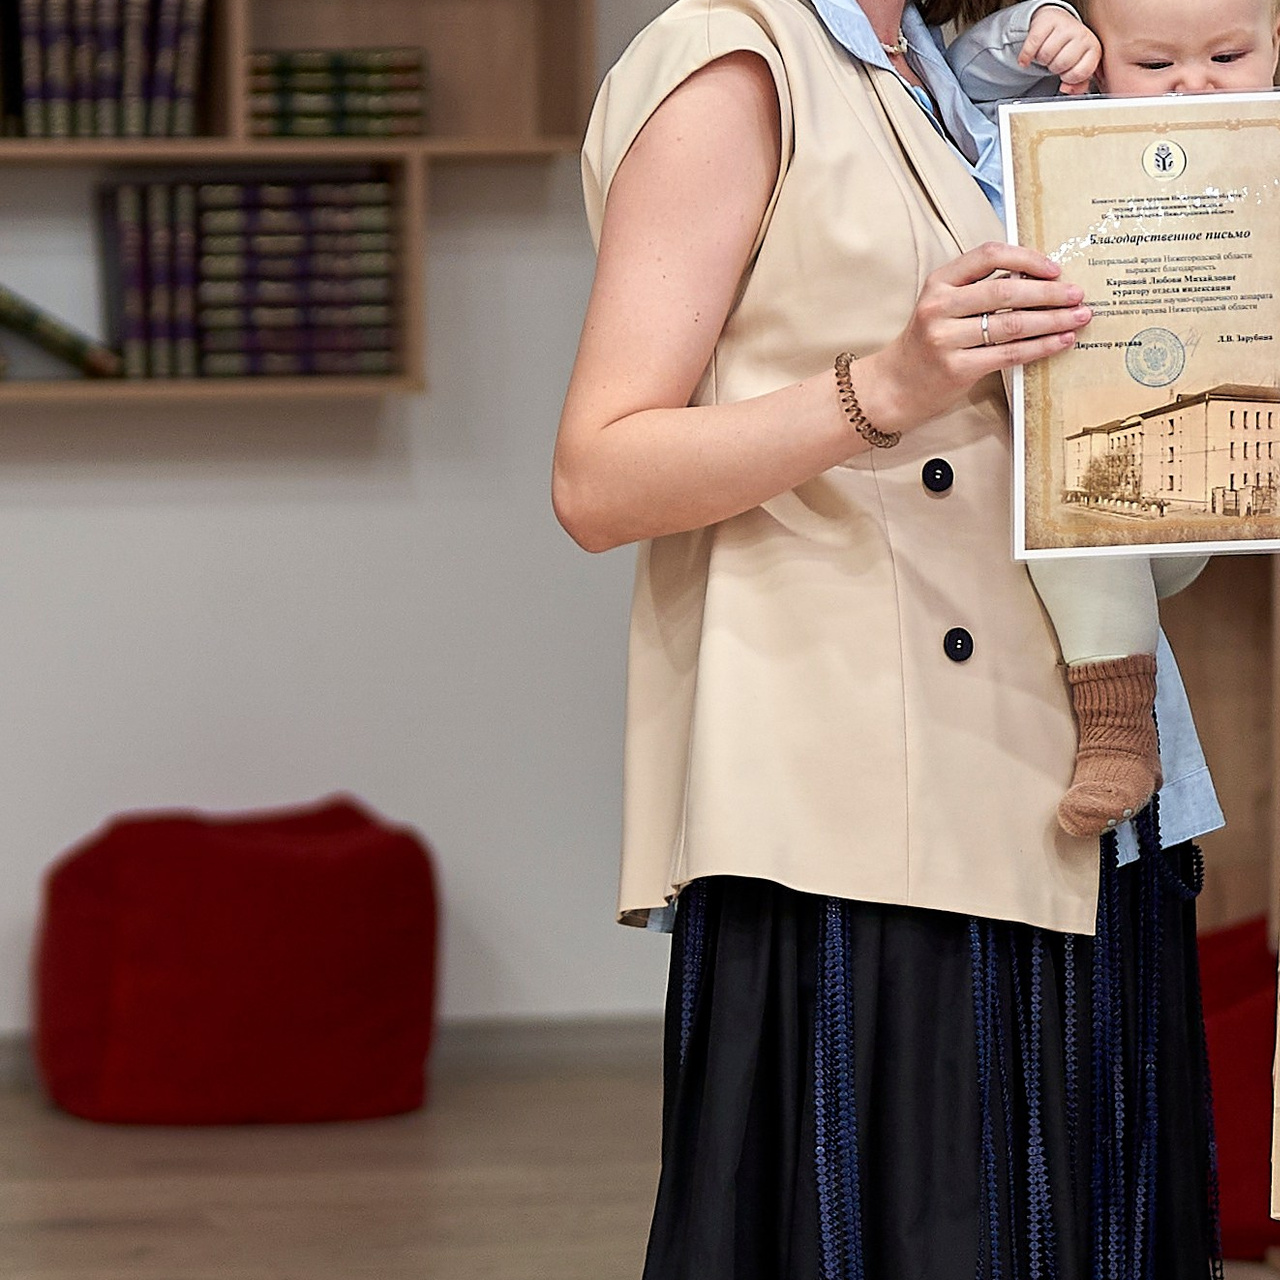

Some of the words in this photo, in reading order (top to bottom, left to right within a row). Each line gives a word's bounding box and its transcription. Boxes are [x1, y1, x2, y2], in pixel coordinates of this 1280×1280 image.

[1090, 231, 1202, 246] Благодарственное
[1205, 229, 1251, 241] письмо
[1088, 257, 1138, 267] Центральный
[1140, 256, 1162, 266] архив
[1164, 252, 1222, 263] Нижегородской
[1223, 251, 1253, 260] области
[1162, 263, 1216, 273] благодарность
[1149, 276, 1182, 285] Любови
[1113, 288, 1150, 297] куратору
[1228, 302, 1258, 311] области
[1074, 340, 1113, 350] Директор
